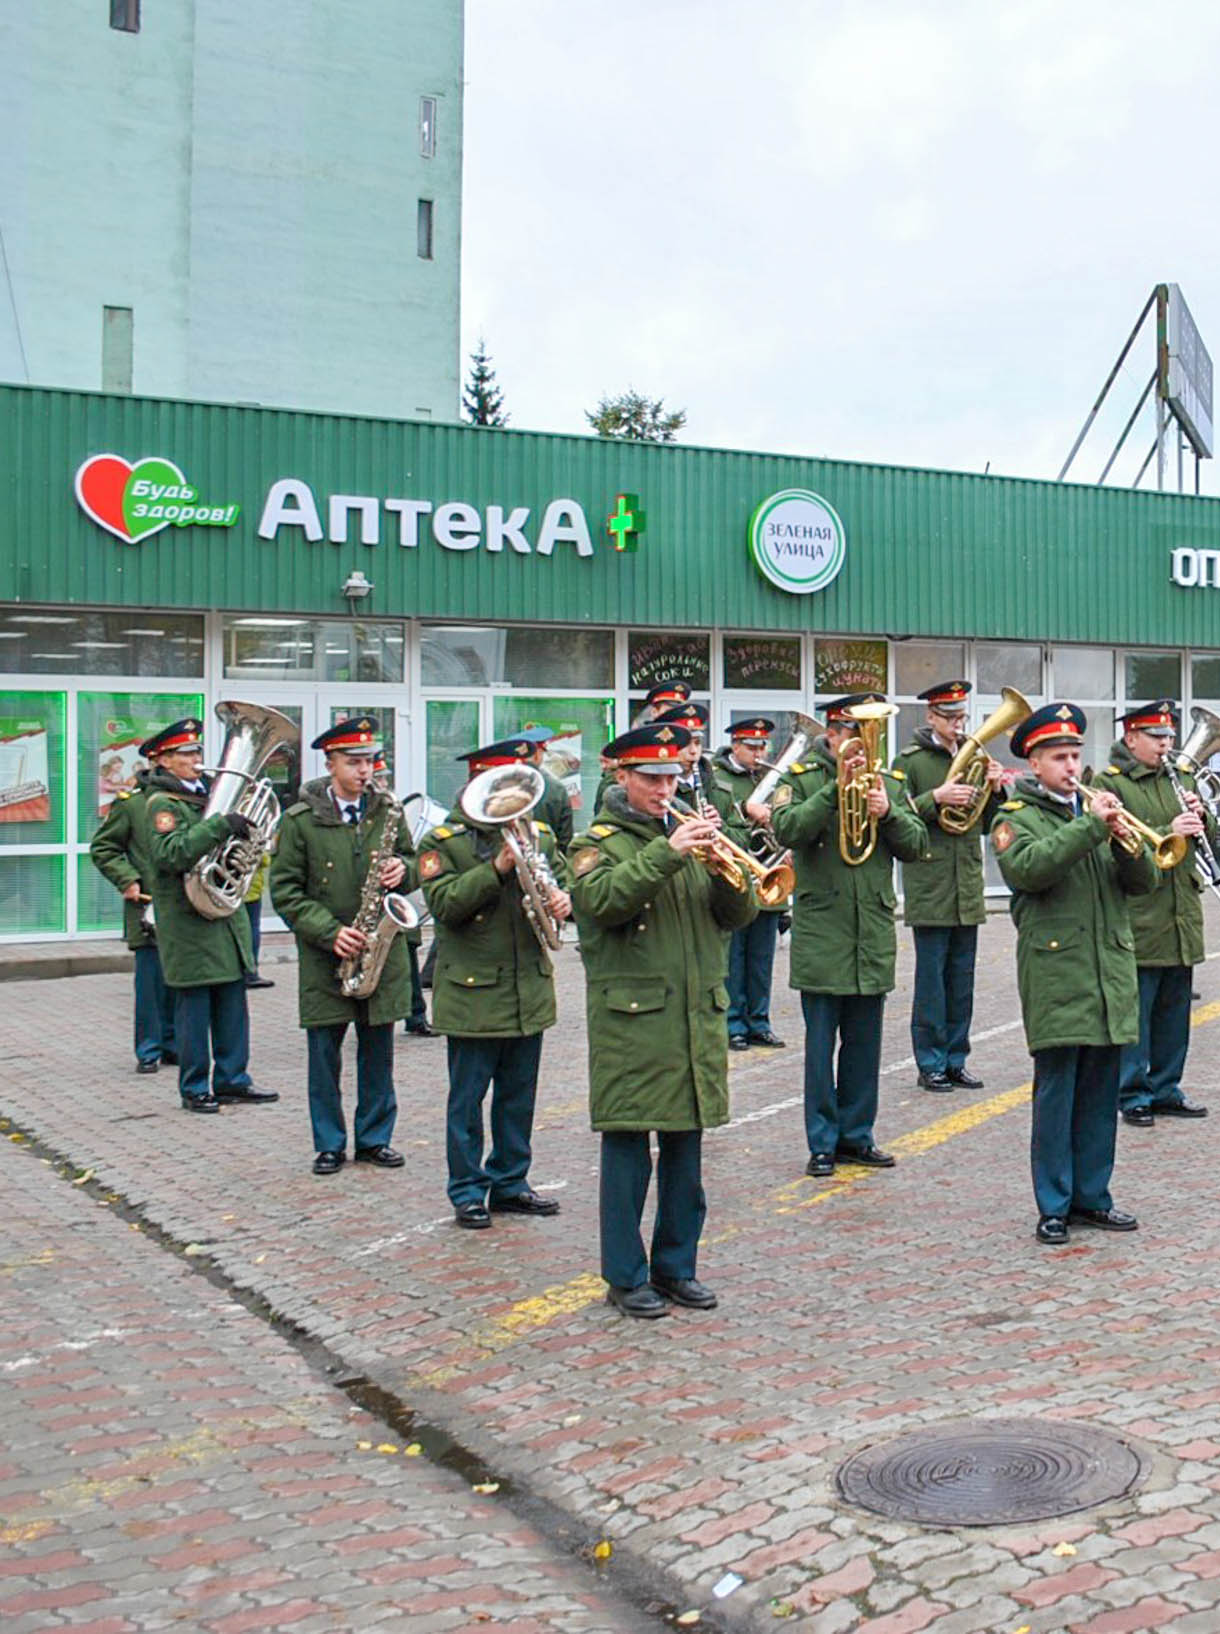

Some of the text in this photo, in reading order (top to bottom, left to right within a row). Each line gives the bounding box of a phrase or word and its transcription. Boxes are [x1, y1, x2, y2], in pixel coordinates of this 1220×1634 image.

[131, 480, 194, 500] Будь
[131, 504, 235, 523] здоров!
[767, 523, 832, 541] ЗЕЛЕНАЯ
[773, 541, 825, 561] УЛИЦА
